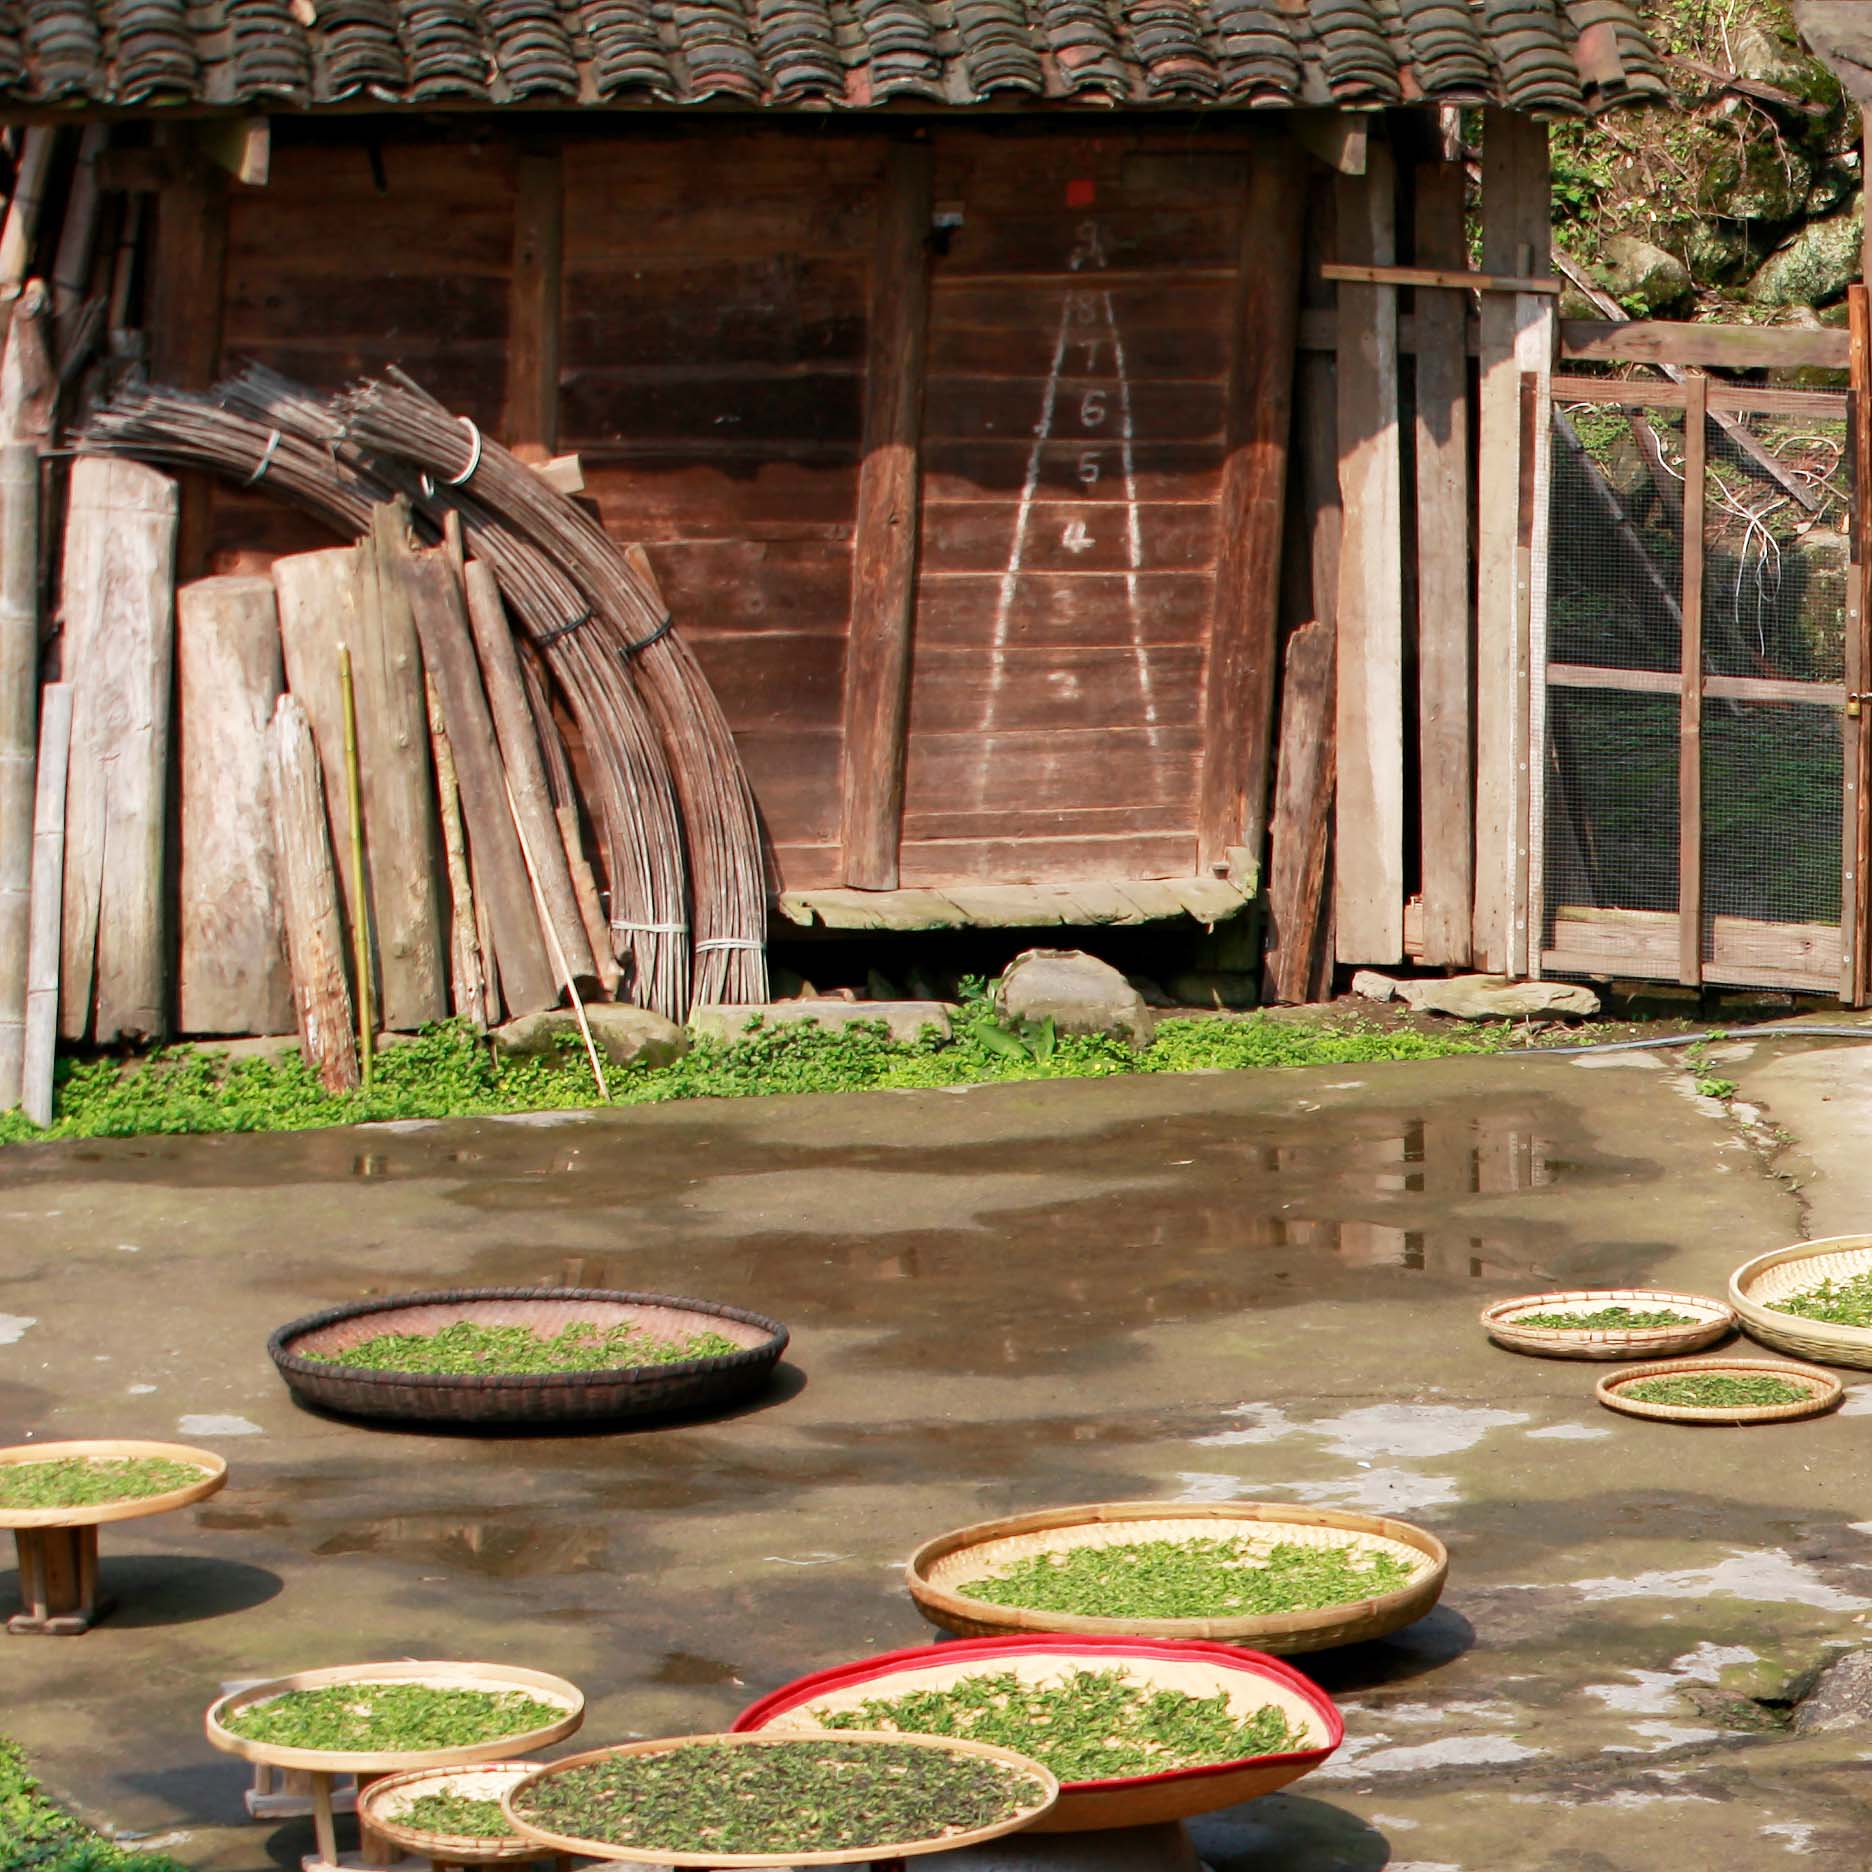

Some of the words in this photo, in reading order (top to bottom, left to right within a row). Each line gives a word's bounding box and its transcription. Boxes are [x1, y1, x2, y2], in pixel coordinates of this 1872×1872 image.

[1080, 389, 1107, 428] 6
[1078, 452, 1100, 483] 5
[1061, 519, 1097, 554] 4
